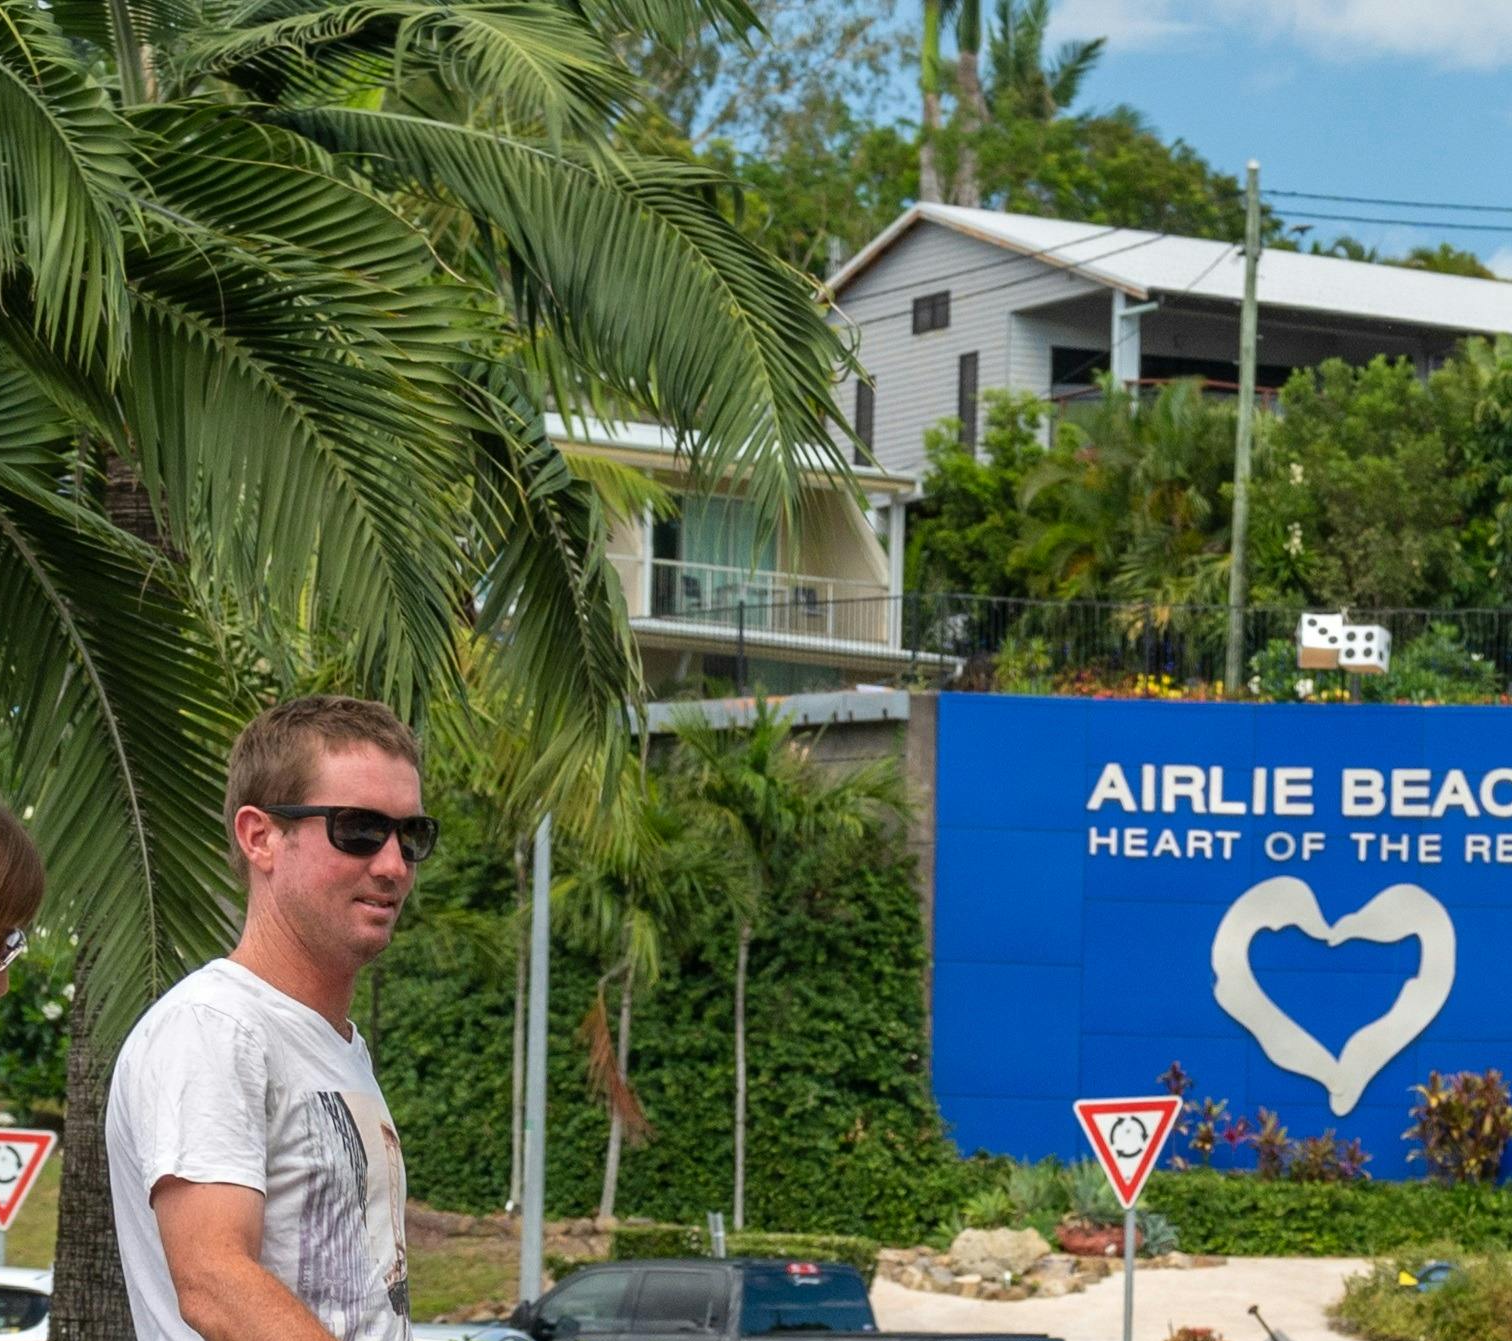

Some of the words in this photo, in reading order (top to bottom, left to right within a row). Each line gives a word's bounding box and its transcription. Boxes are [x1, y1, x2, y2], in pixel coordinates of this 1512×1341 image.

[1087, 763, 1314, 816] AIRLIE
[1089, 827, 1241, 859] HEART
[1265, 832, 1325, 861] OF
[1350, 832, 1442, 863] THE
